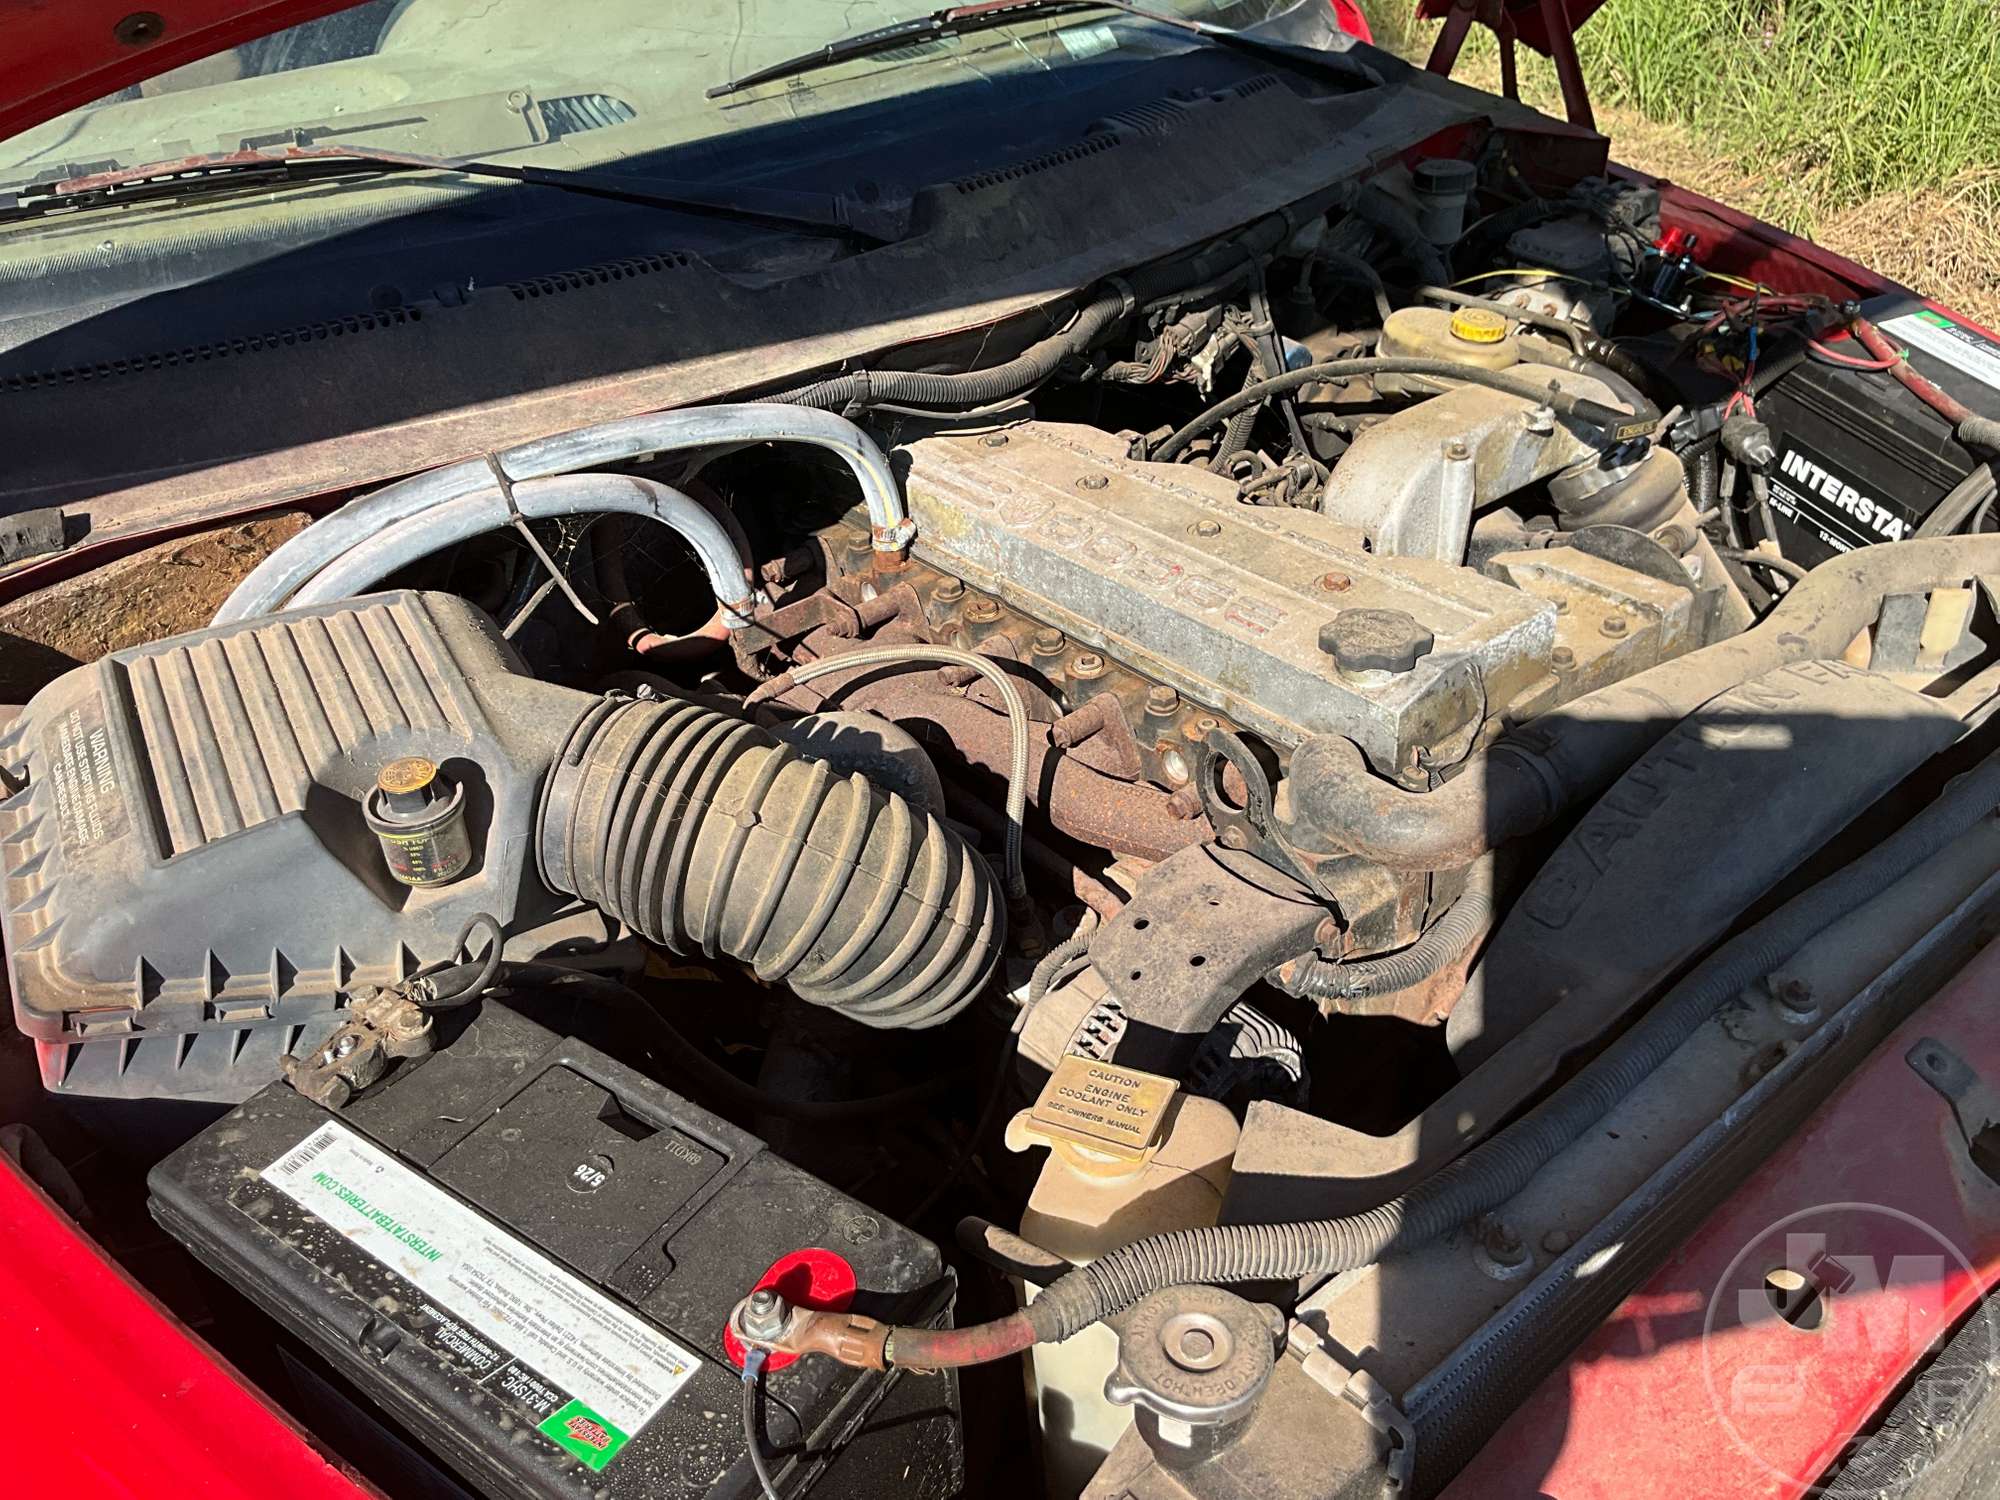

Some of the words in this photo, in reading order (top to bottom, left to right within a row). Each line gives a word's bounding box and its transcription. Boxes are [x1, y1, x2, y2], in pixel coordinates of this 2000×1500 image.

[69, 708, 80, 723] DO
[71, 721, 83, 741] NOT
[57, 720, 74, 769] IMMEDIATE
[74, 739, 87, 760] USE
[52, 762, 64, 785] CAN
[88, 727, 115, 794] WARNING
[65, 766, 81, 804] ENGINE
[78, 758, 96, 805] STARTING
[72, 801, 89, 845] DAMAGE
[87, 802, 104, 840] FLUIDS
[1082, 1083, 1132, 1103] ENGINE
[1086, 1068, 1142, 1089] CAUTION
[1045, 1100, 1067, 1111] SEE
[1065, 1107, 1105, 1122] OWNERS
[1104, 1118, 1143, 1134] MANUAL
[1056, 1086, 1114, 1108] COOLANT
[1114, 1103, 1148, 1117] ONLY
[574, 1164, 606, 1187] 5/26
[310, 1170, 443, 1263] INTERSTATEBATTERIES.COM
[419, 1301, 459, 1332] REPLACEMENT
[433, 1325, 493, 1370] COMMERCIAL
[455, 1328, 472, 1341] FREE
[468, 1337, 500, 1361] 12-MONTH
[500, 1374, 551, 1413] M-31SHC
[544, 1390, 559, 1403] CCA
[565, 1418, 607, 1449] INTERSTATE
[574, 1415, 611, 1444] BATTERIES
